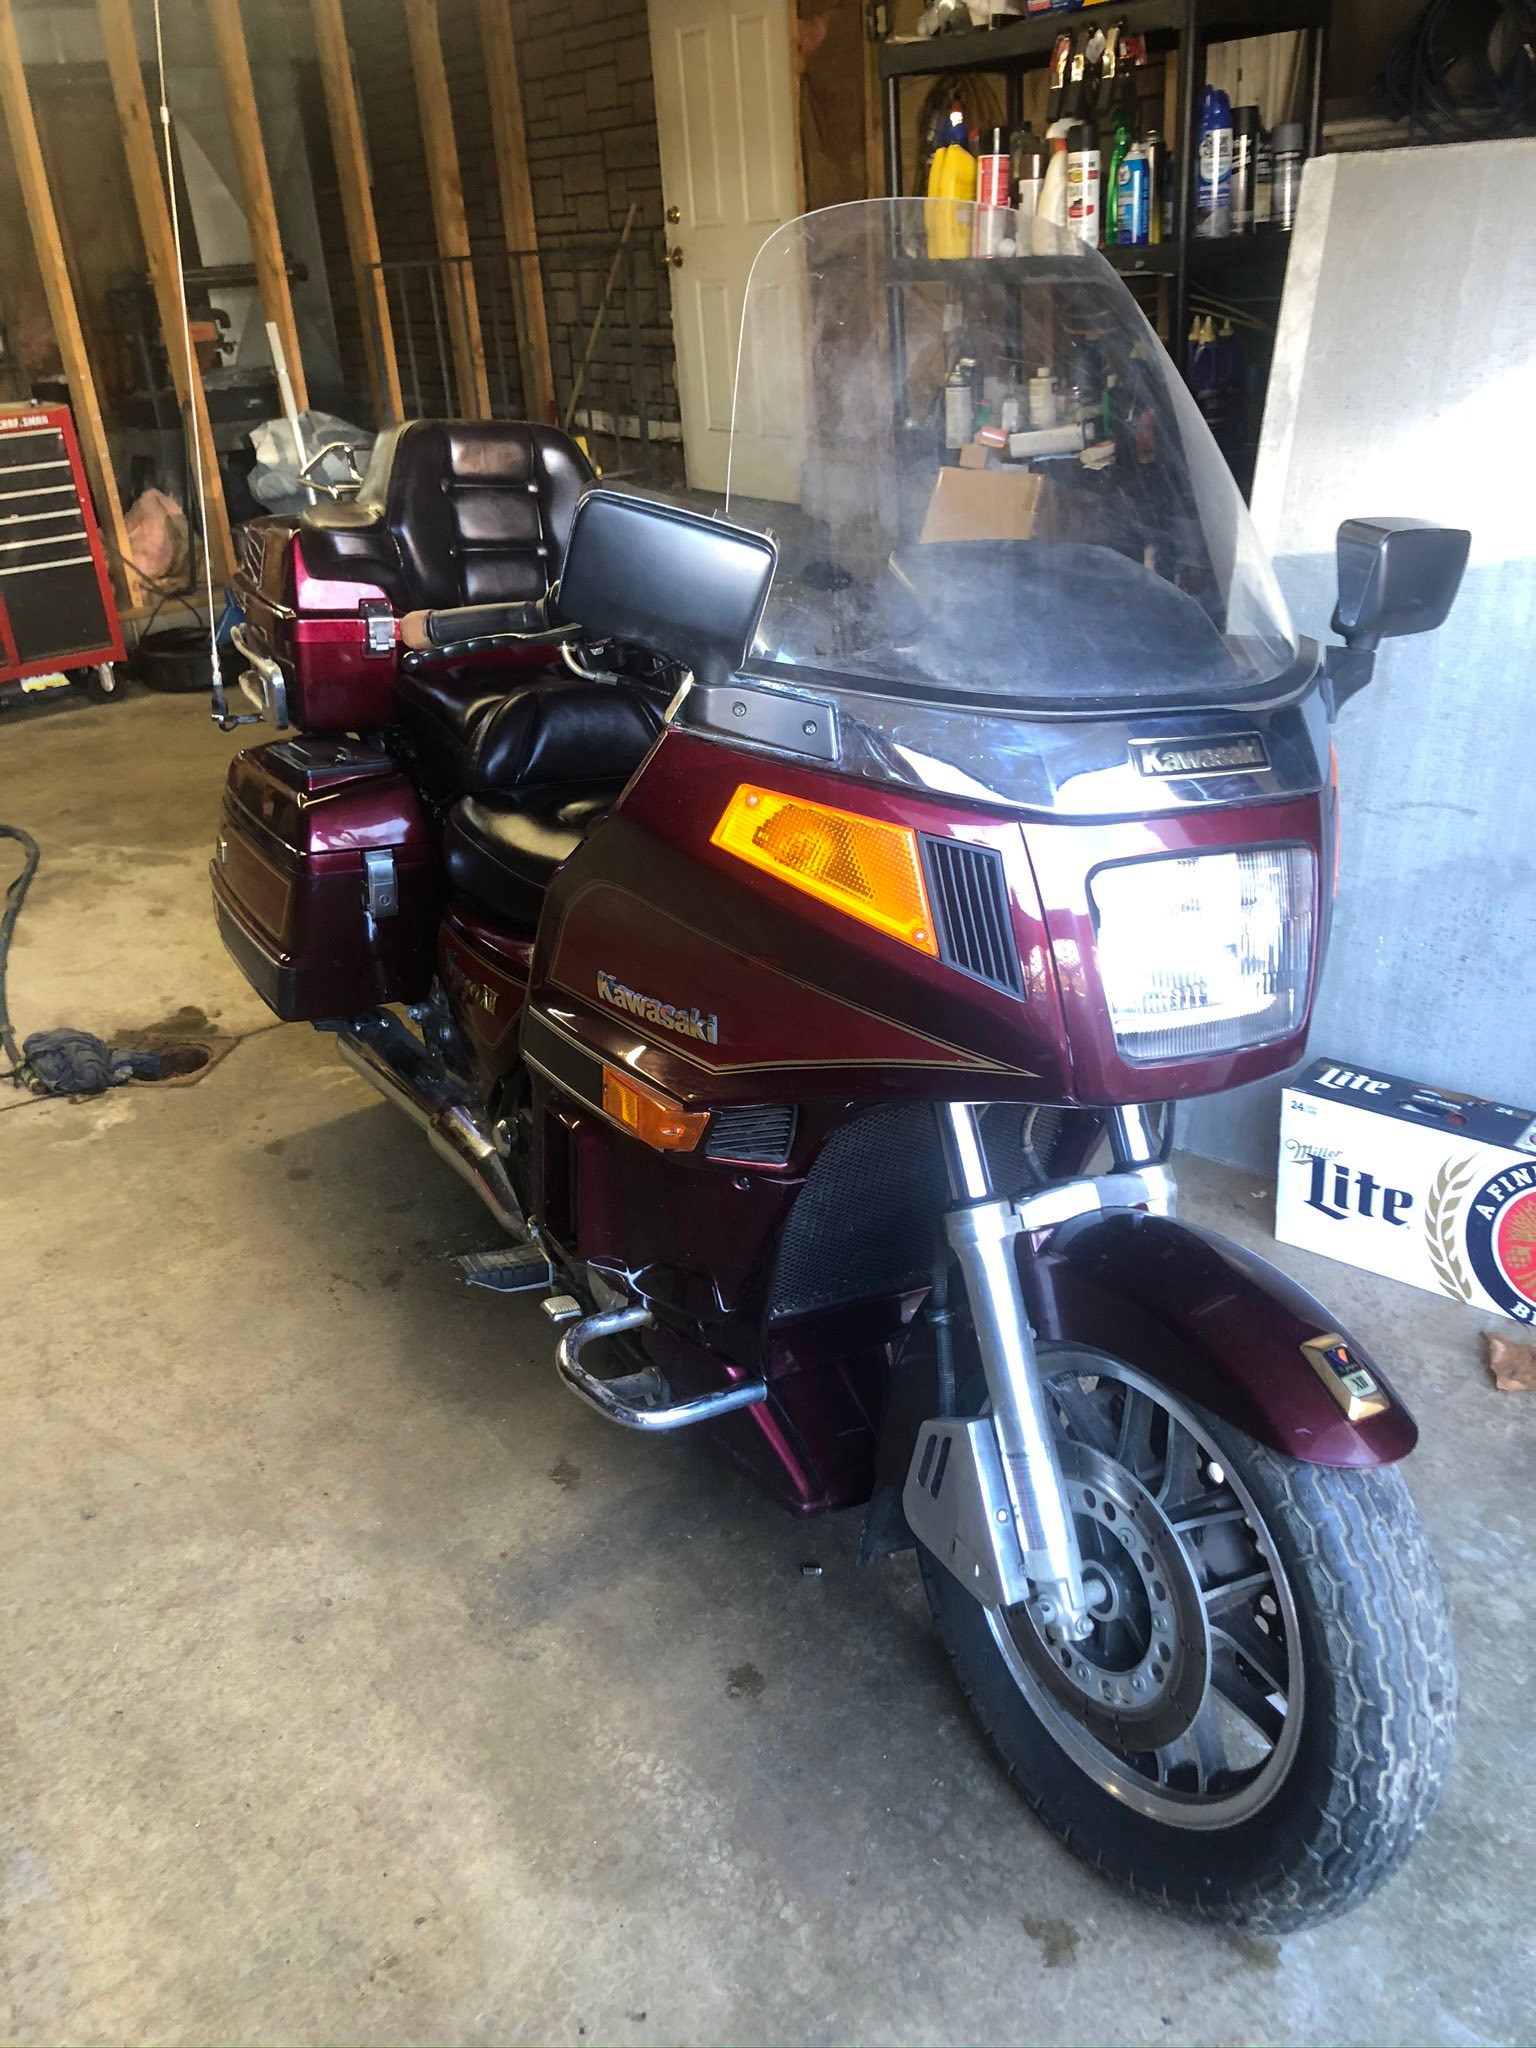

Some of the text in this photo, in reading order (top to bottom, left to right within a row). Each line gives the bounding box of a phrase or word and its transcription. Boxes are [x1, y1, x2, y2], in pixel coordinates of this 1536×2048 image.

[1140, 738, 1265, 774] Kawasaki
[596, 969, 719, 1045] Kawasaki
[1313, 1066, 1391, 1096] Lite
[1290, 1100, 1304, 1111] 24
[1285, 1138, 1344, 1161] Miller
[1303, 1153, 1414, 1226] Lite
[1475, 1165, 1536, 1221] A FIN
